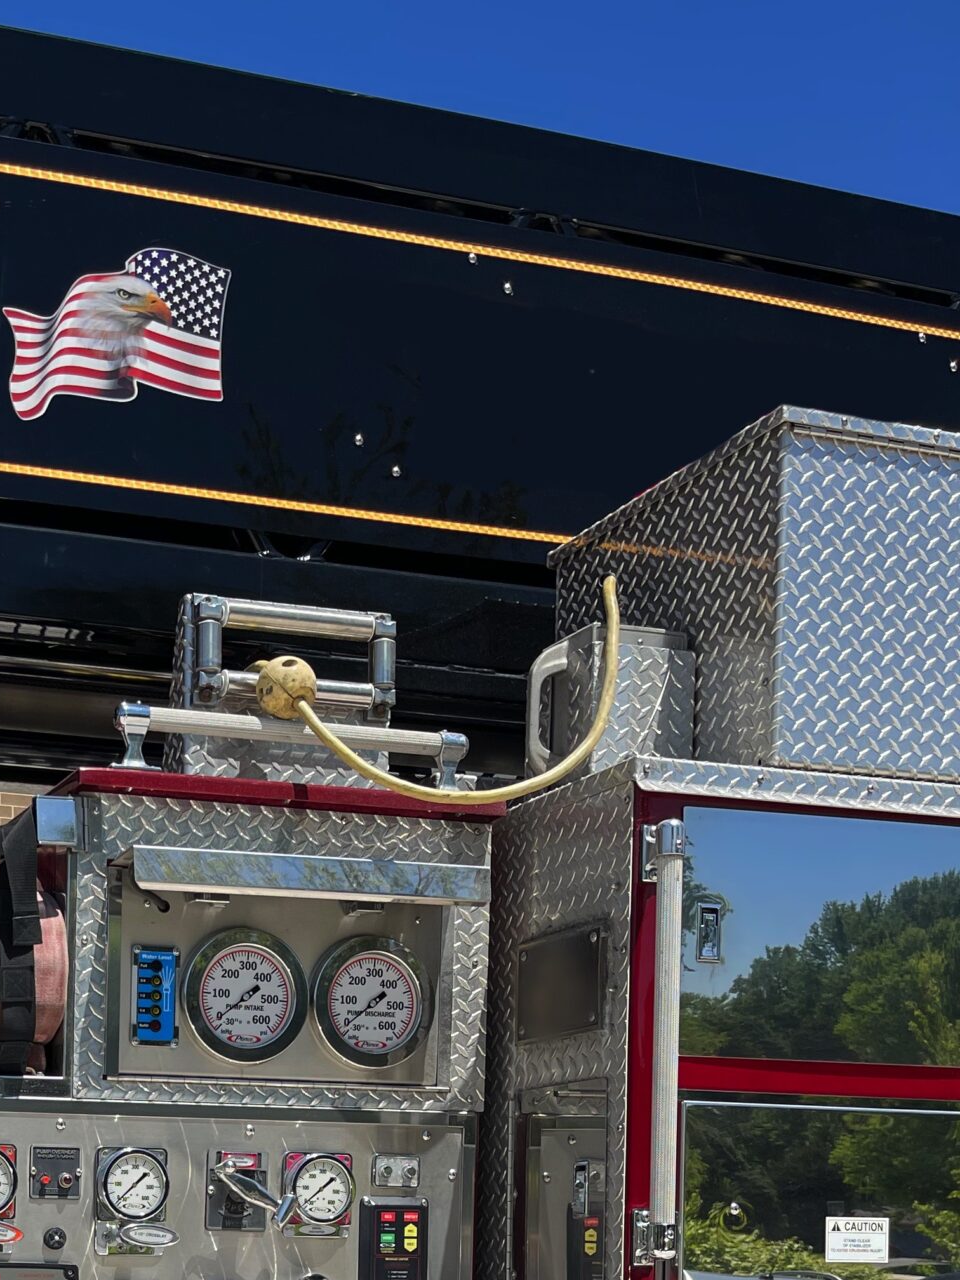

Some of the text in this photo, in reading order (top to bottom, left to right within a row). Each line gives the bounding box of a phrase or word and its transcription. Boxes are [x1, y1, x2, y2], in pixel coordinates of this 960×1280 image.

[239, 961, 257, 970] 300
[221, 969, 240, 978] 200
[366, 968, 383, 977] 300
[253, 973, 272, 982] 400
[349, 976, 366, 985] 200
[380, 980, 397, 989] 400
[213, 989, 230, 998] 100
[261, 995, 279, 1004] 500
[340, 995, 357, 1004] 100
[387, 1001, 404, 1010] 500
[252, 1015, 270, 1025] 600
[378, 1021, 396, 1030] 600
[844, 1222, 883, 1231] CAUTION
